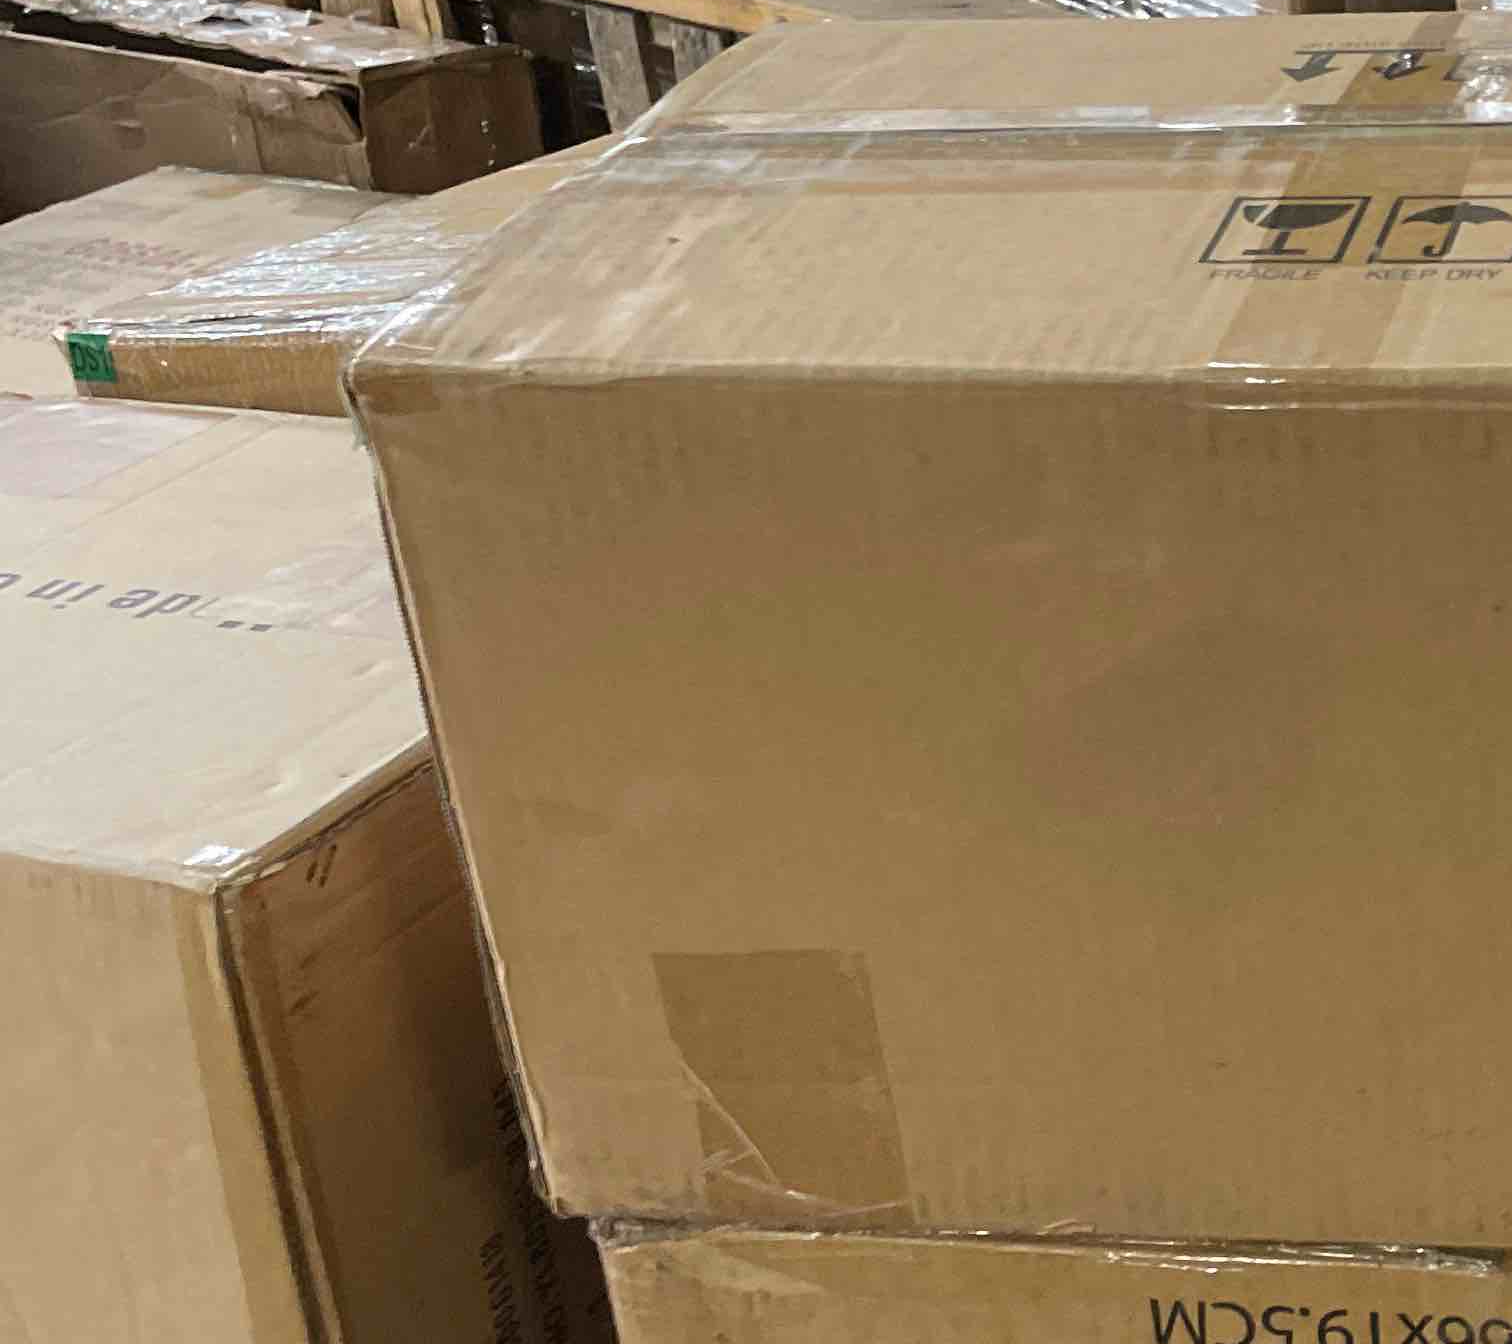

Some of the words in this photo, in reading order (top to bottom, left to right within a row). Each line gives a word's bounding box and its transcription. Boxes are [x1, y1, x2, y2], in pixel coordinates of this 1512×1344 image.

[1209, 268, 1321, 281] FRAGILE
[1366, 268, 1438, 281] KEEP
[1444, 268, 1504, 282] DRY
